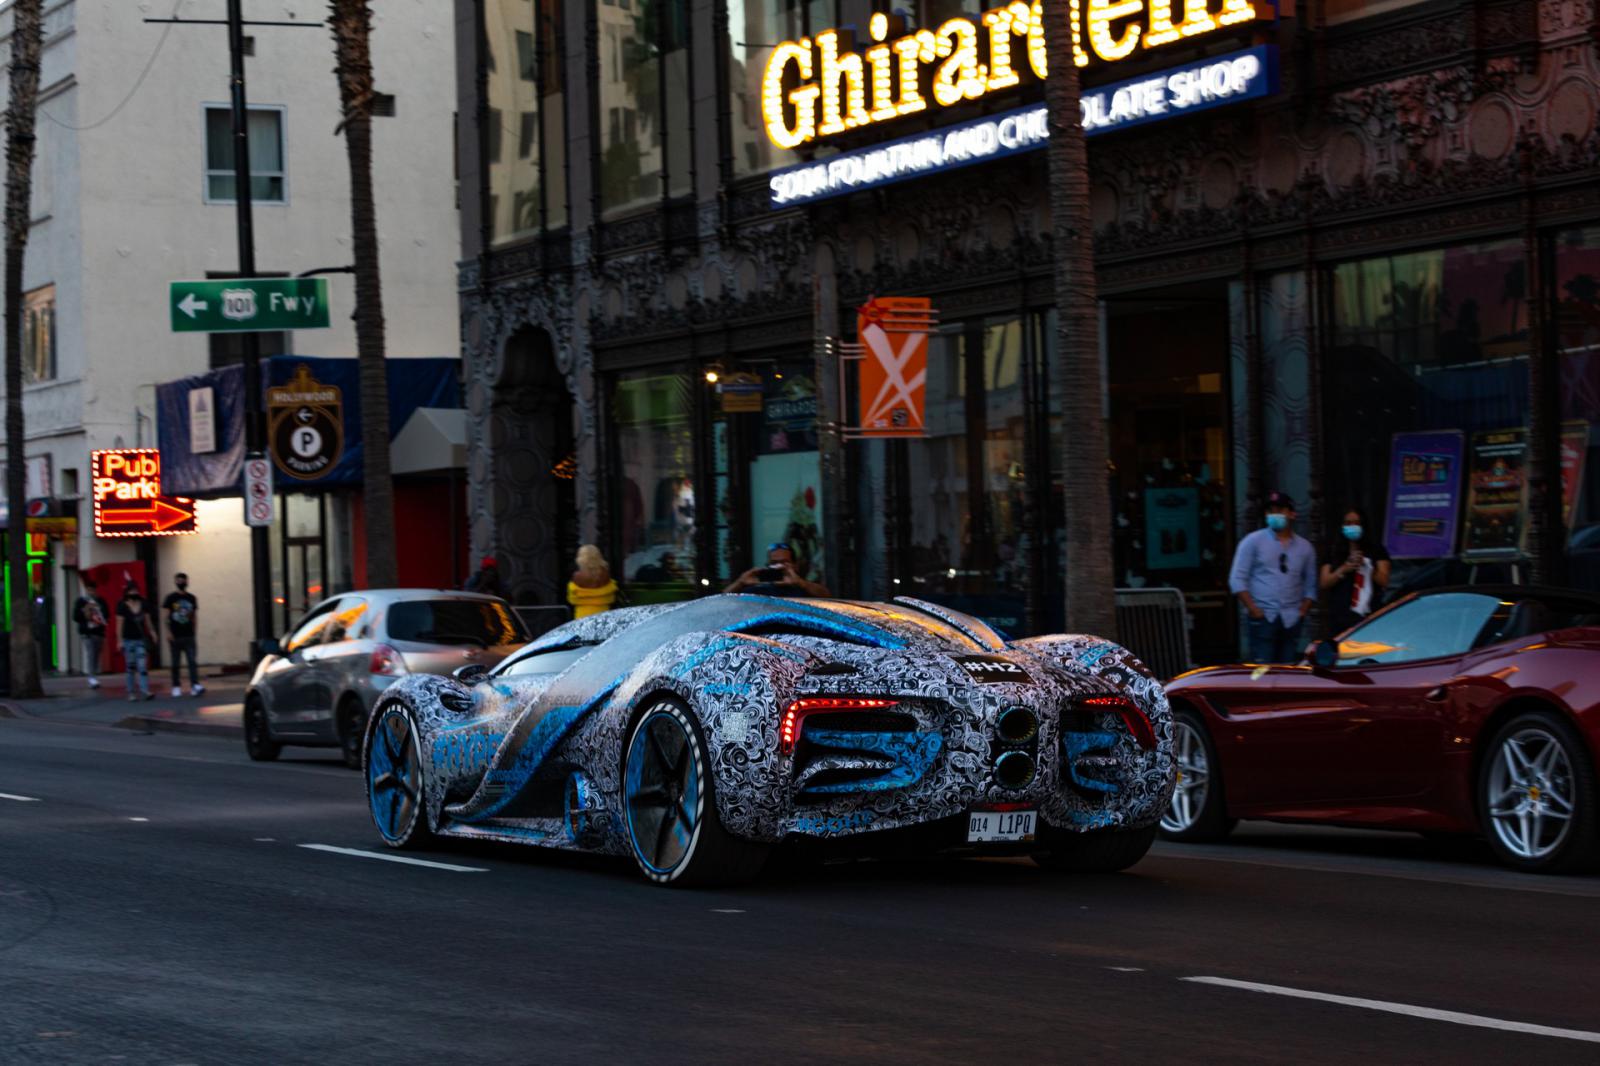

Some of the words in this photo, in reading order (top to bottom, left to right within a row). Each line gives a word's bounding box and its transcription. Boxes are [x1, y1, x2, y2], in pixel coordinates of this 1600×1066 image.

[769, 163, 829, 204] SODA
[828, 132, 946, 190] FOUNTAIN
[943, 120, 1001, 162] AND
[997, 74, 1169, 150] CHOLATE
[1167, 53, 1261, 108] SHOP
[227, 297, 252, 314] 101
[269, 292, 316, 317] Fwy
[301, 431, 314, 453] P
[963, 661, 1023, 673] #H2
[970, 817, 989, 833] 014
